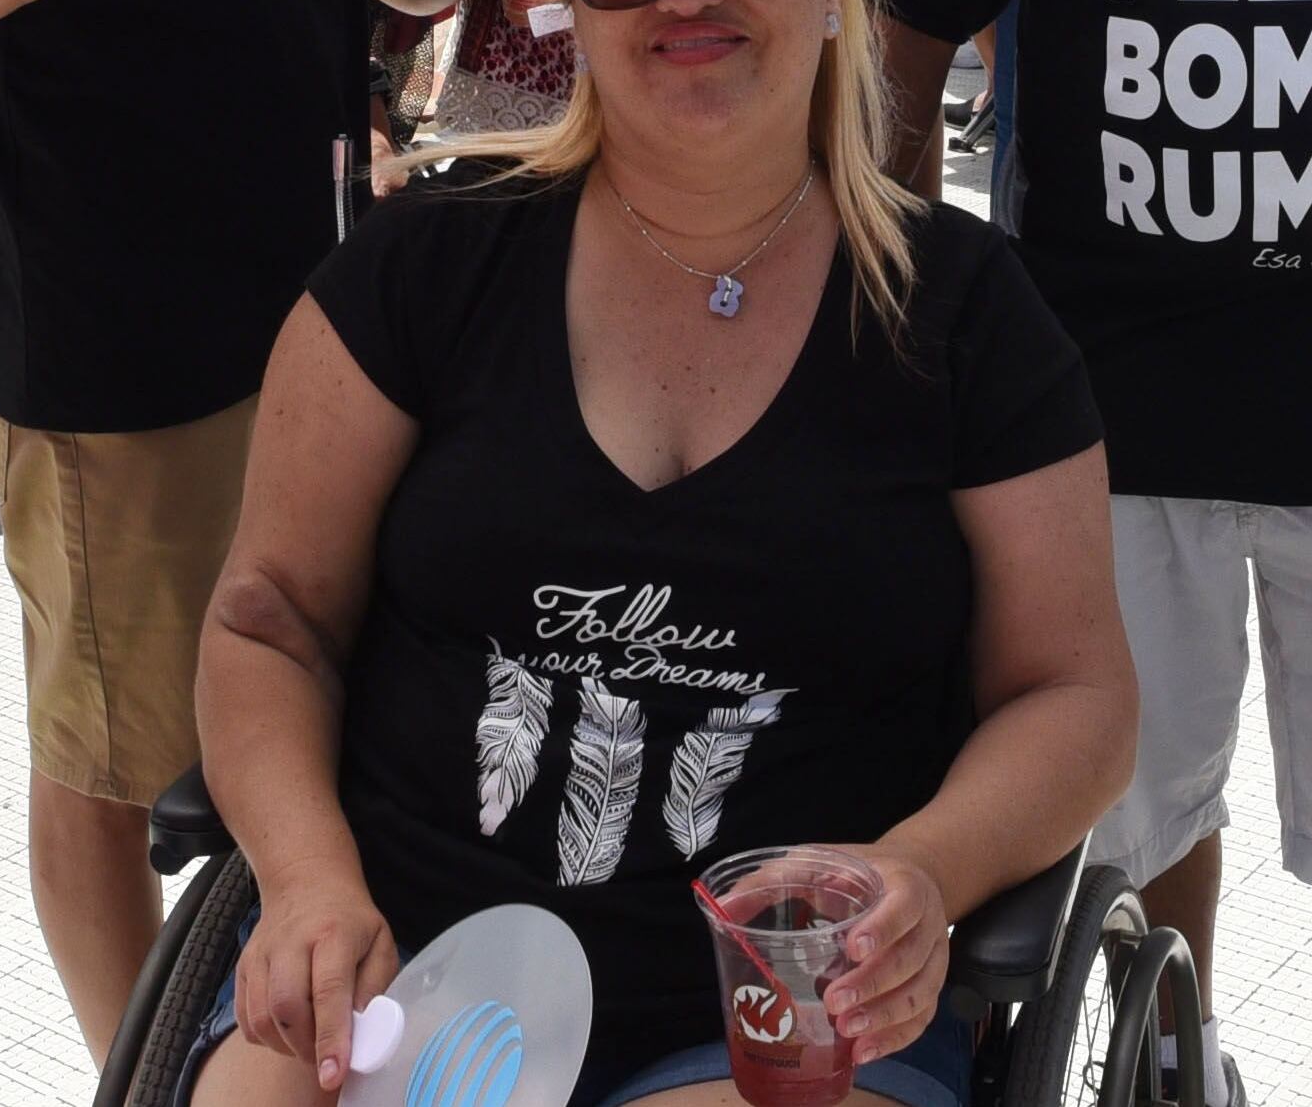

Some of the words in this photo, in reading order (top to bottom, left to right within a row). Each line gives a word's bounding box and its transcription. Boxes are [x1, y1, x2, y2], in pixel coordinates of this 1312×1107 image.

[1253, 248, 1301, 269] Esa
[533, 583, 737, 649] Follow
[609, 644, 767, 694] Dreams
